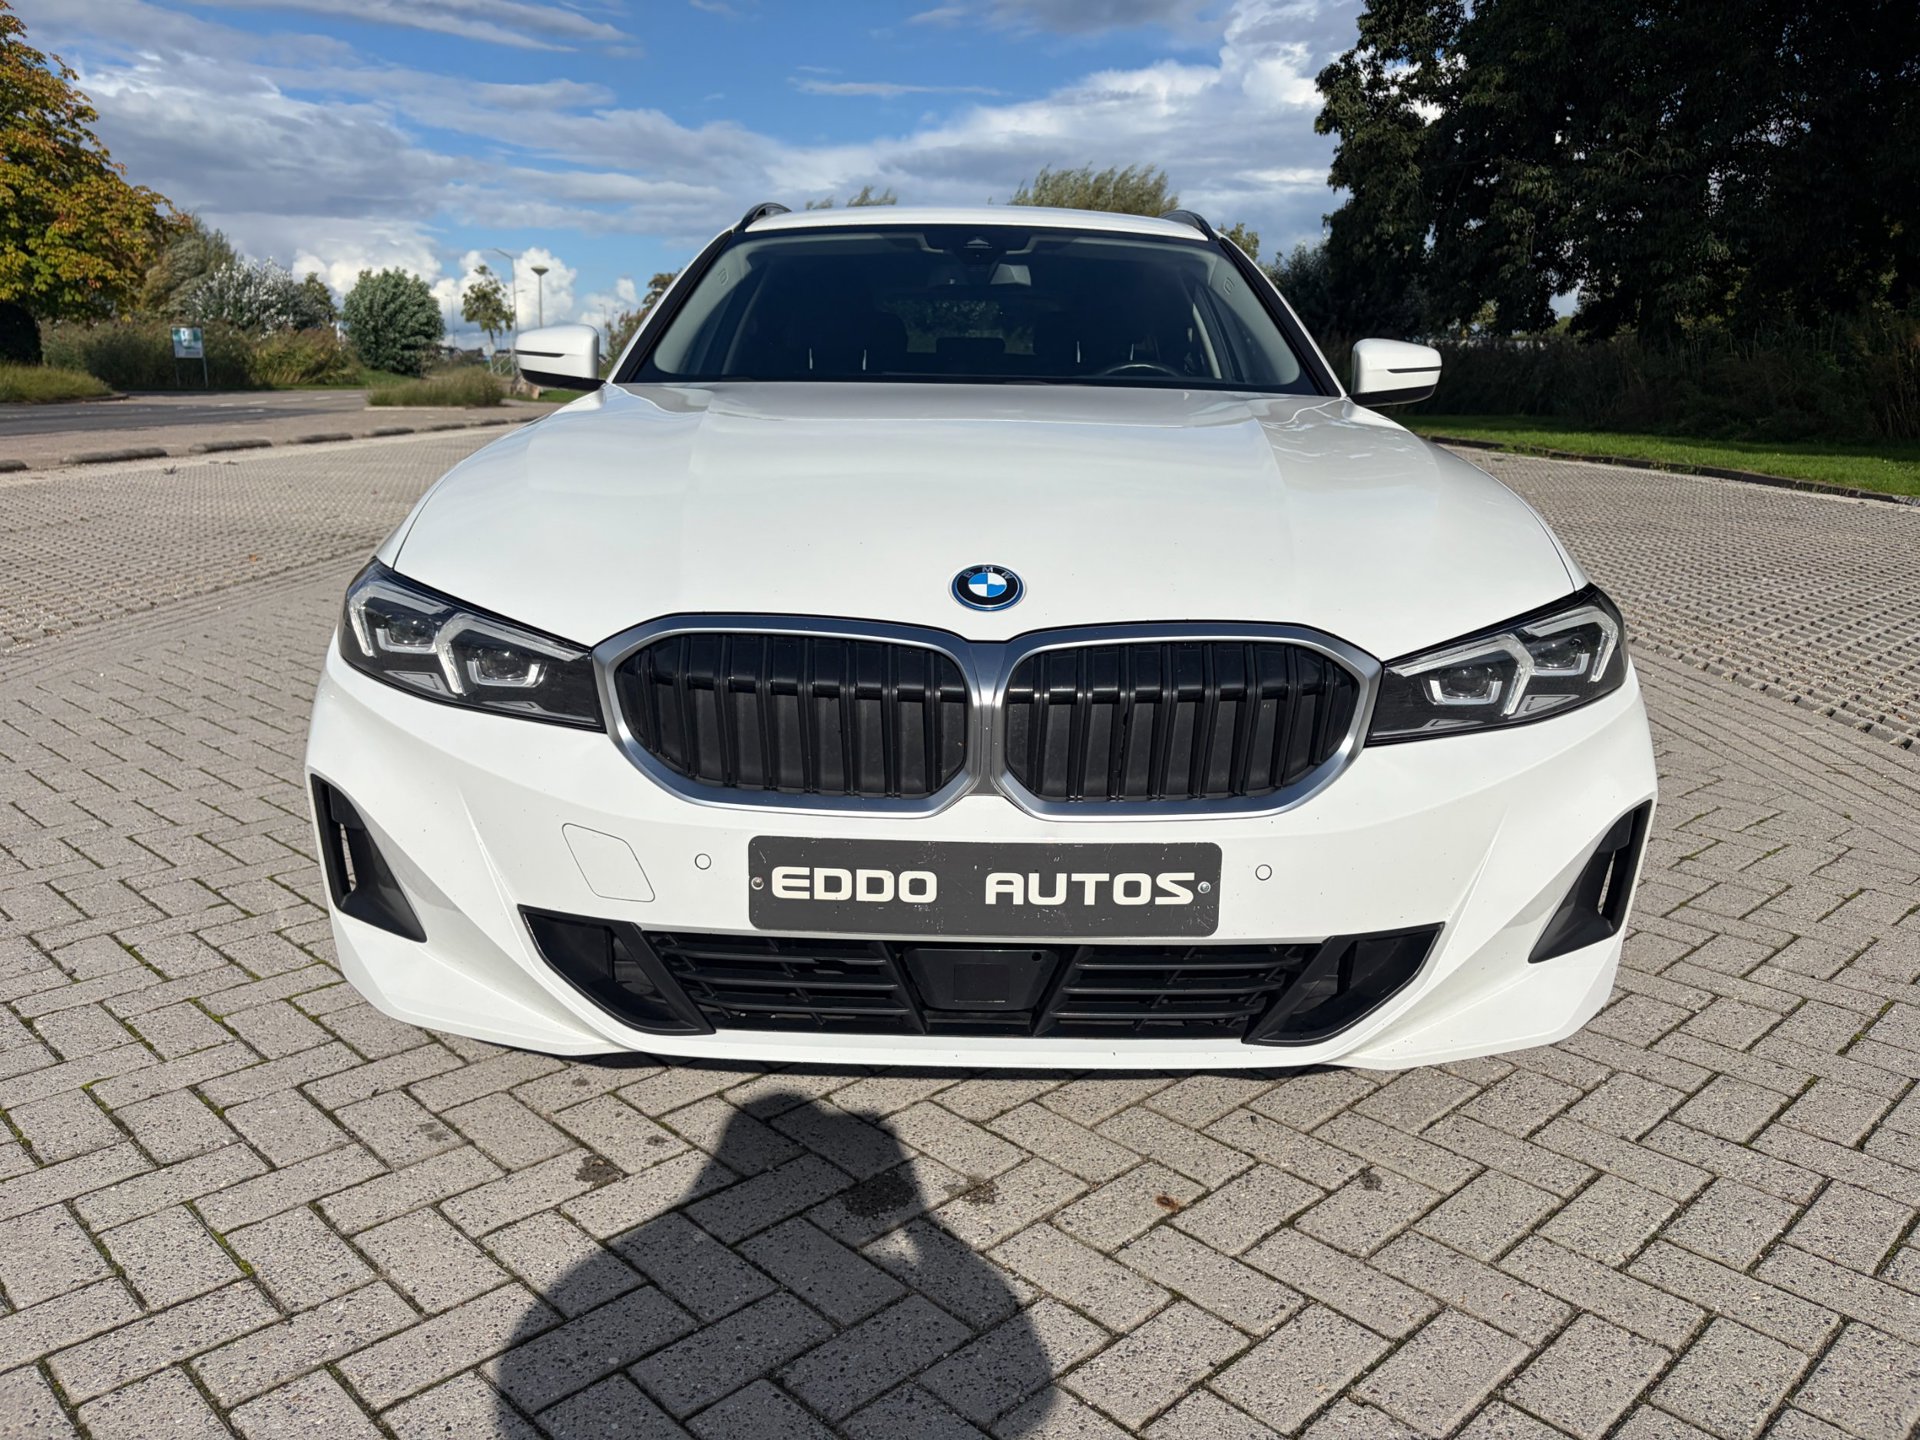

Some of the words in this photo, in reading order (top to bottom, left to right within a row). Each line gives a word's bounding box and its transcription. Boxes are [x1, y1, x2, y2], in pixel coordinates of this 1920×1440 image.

[963, 566, 1013, 579] BMW
[771, 866, 938, 904] EDDO
[985, 872, 1195, 906] AUTOS
